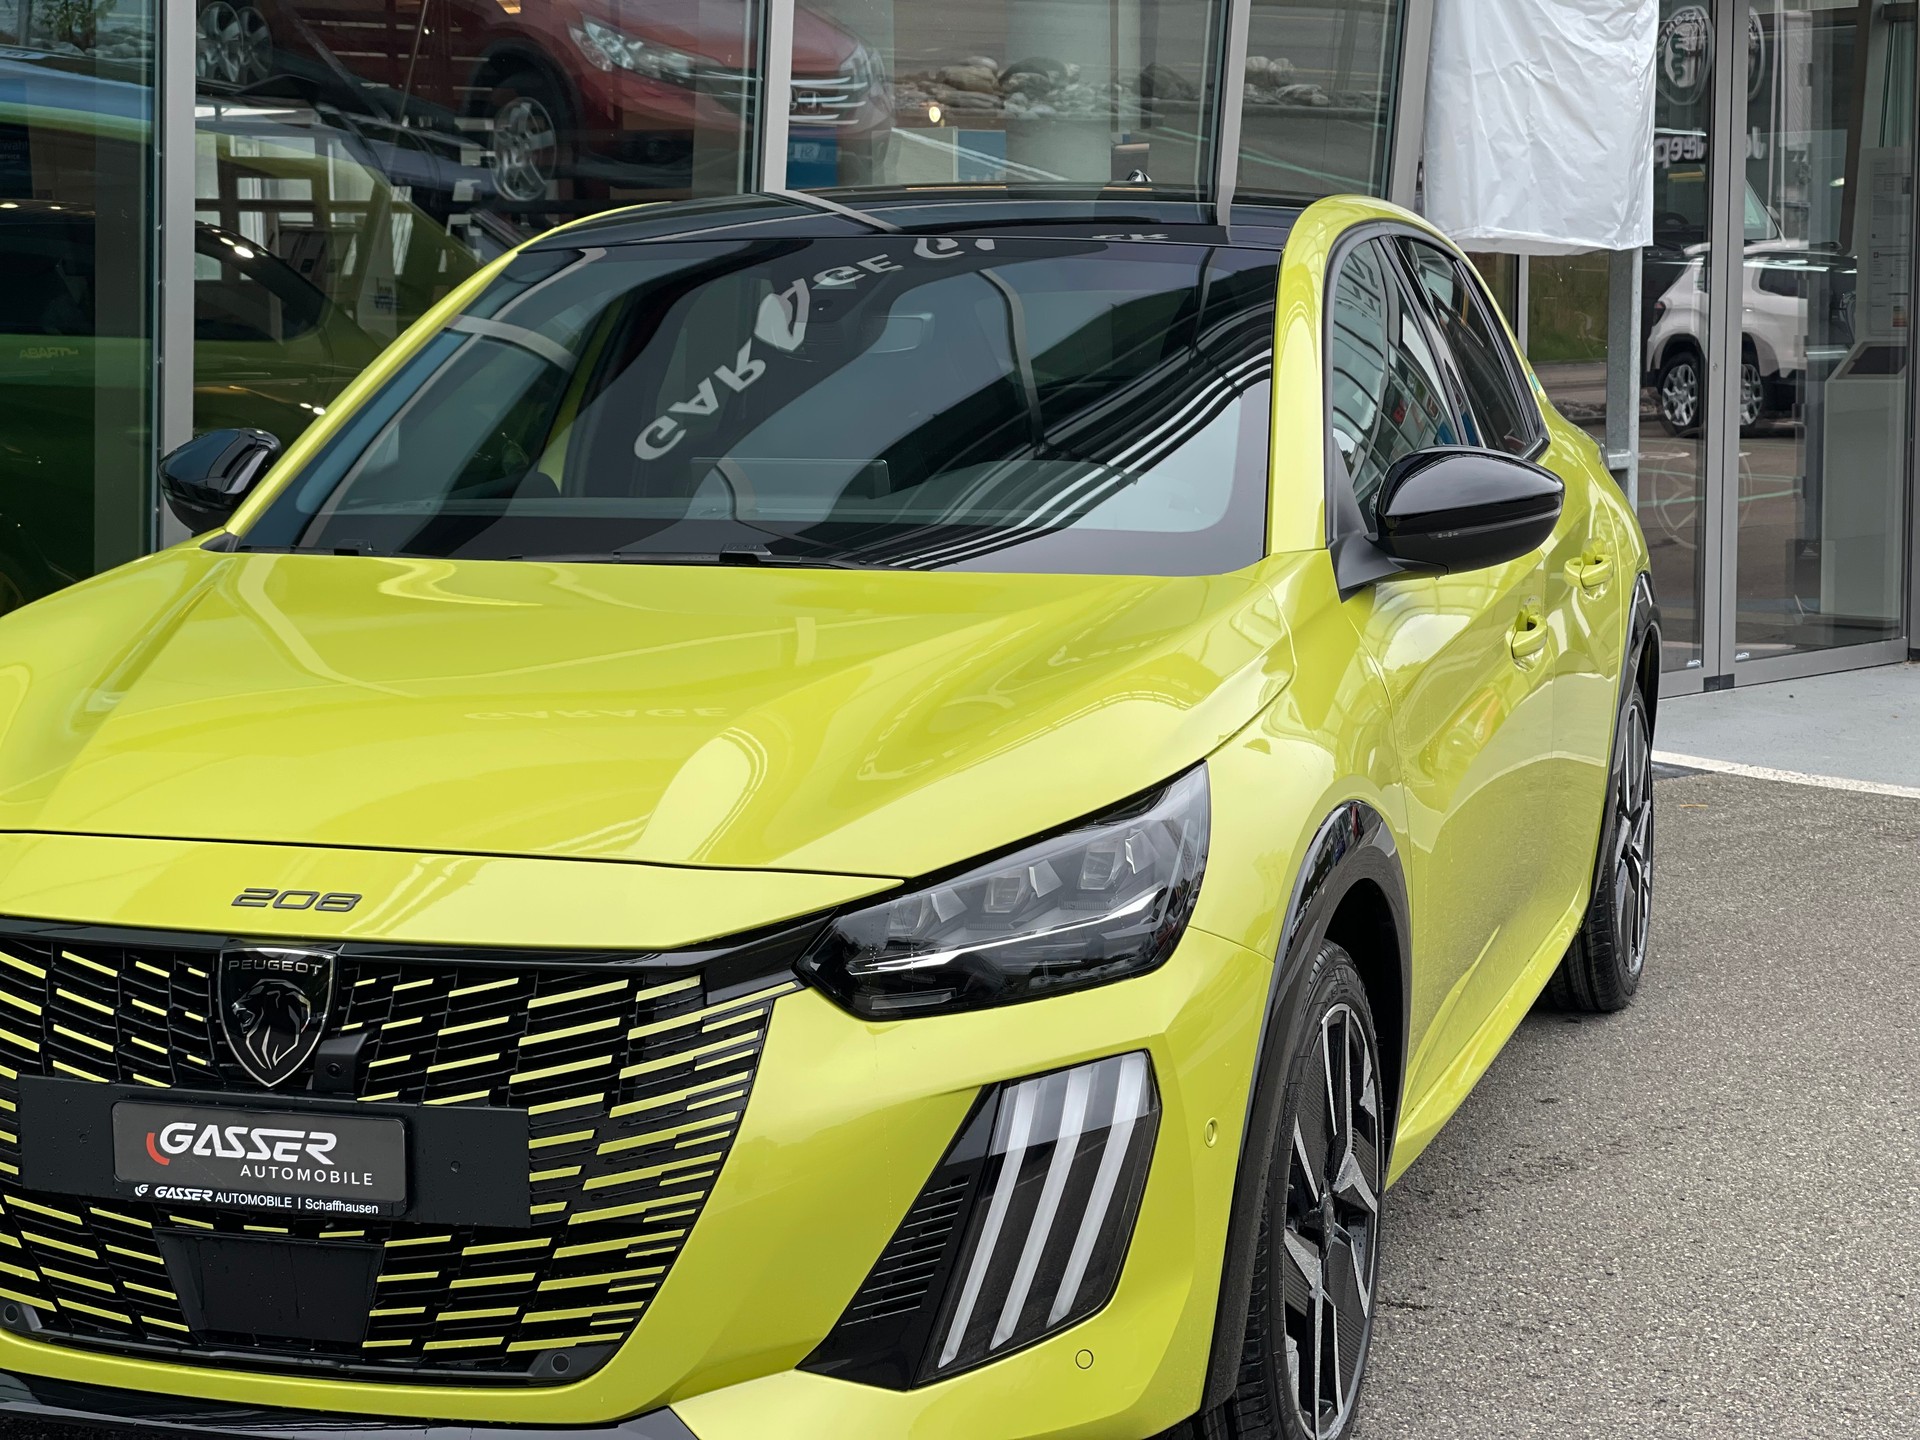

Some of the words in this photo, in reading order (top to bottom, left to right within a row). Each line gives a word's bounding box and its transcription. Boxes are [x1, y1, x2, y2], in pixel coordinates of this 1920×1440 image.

[231, 887, 363, 913] 208
[228, 959, 323, 977] PEUGEOT
[159, 1122, 337, 1166] GASSER
[240, 1164, 373, 1186] AUTOMOBILE
[154, 1186, 213, 1202] GASSER
[214, 1191, 293, 1209] AUTOMOBILE
[304, 1197, 379, 1215] Schaffhausen
